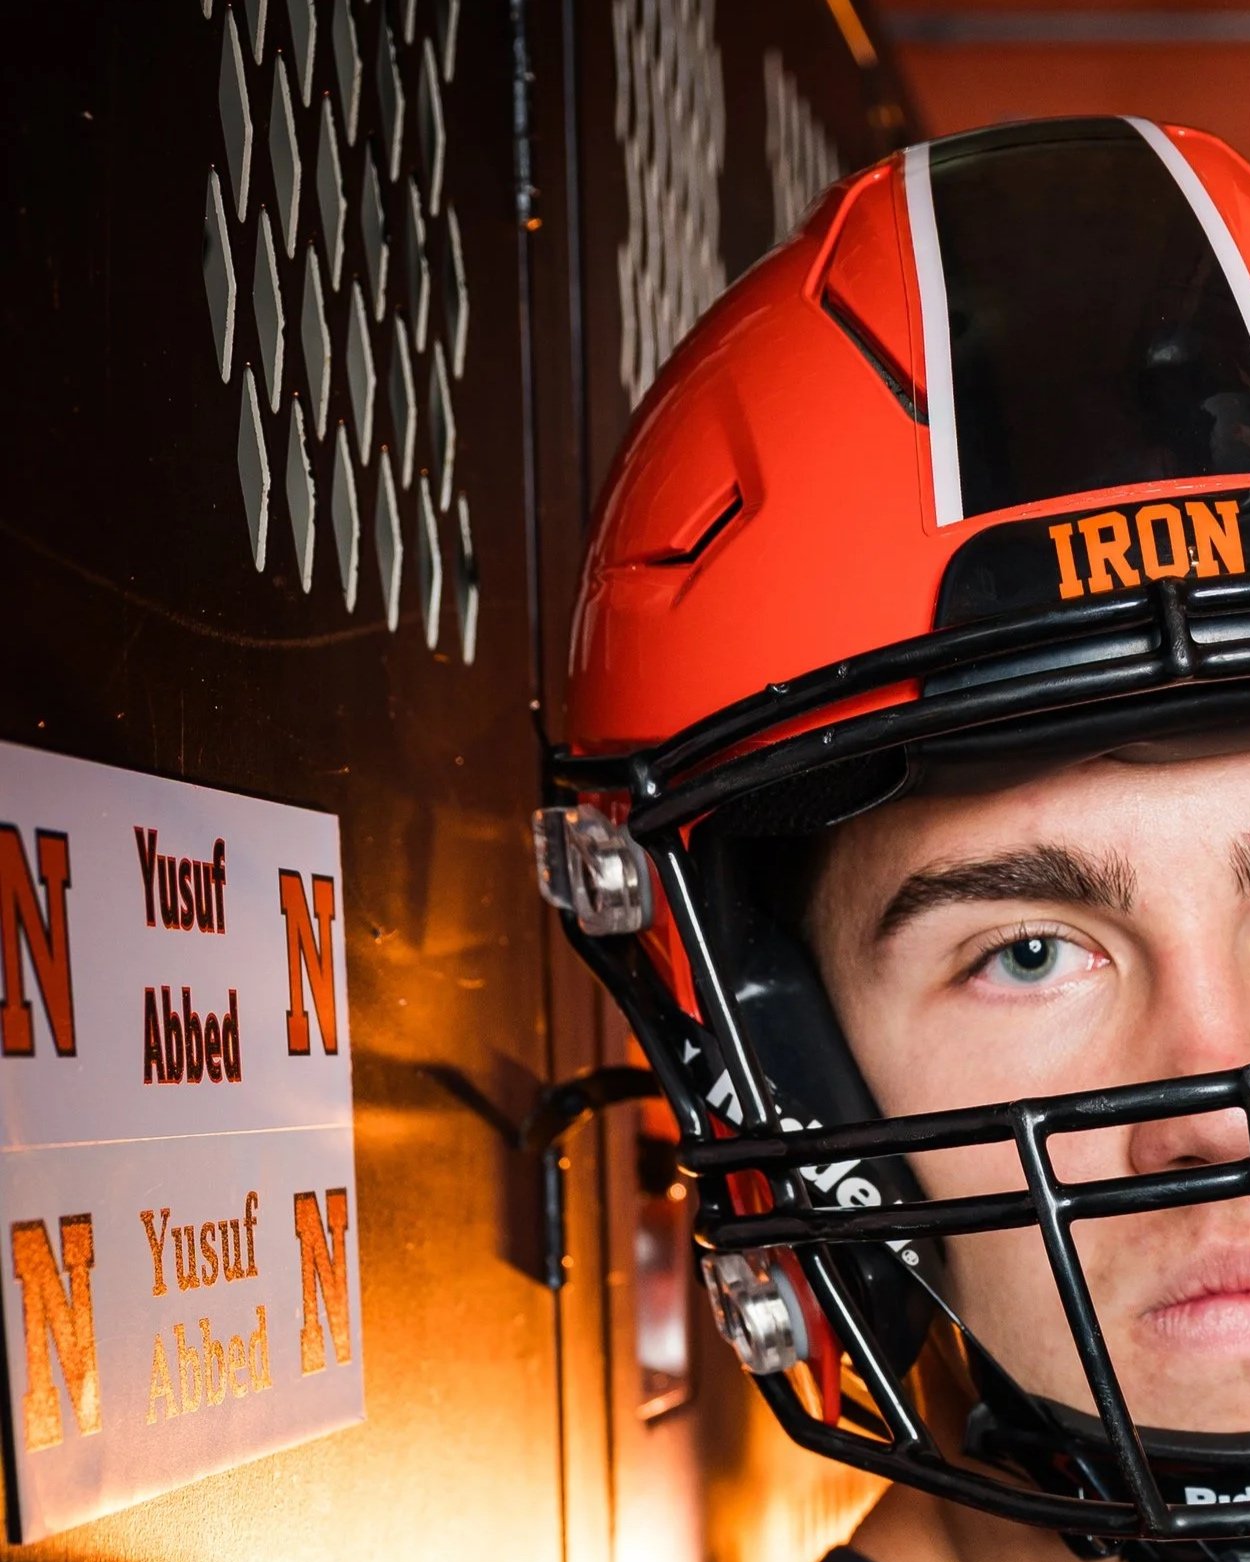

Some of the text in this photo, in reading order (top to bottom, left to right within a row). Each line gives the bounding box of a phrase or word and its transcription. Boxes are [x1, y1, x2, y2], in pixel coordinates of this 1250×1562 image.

[1048, 499, 1247, 600] IRON
[0, 822, 78, 1058] N
[134, 825, 228, 936] Yusuf
[279, 868, 340, 1057] N
[143, 984, 244, 1085] Abbed
[140, 1190, 261, 1299] Yusuf
[293, 1186, 353, 1377] N
[8, 1211, 103, 1455] N
[146, 1305, 273, 1426] Abbed
